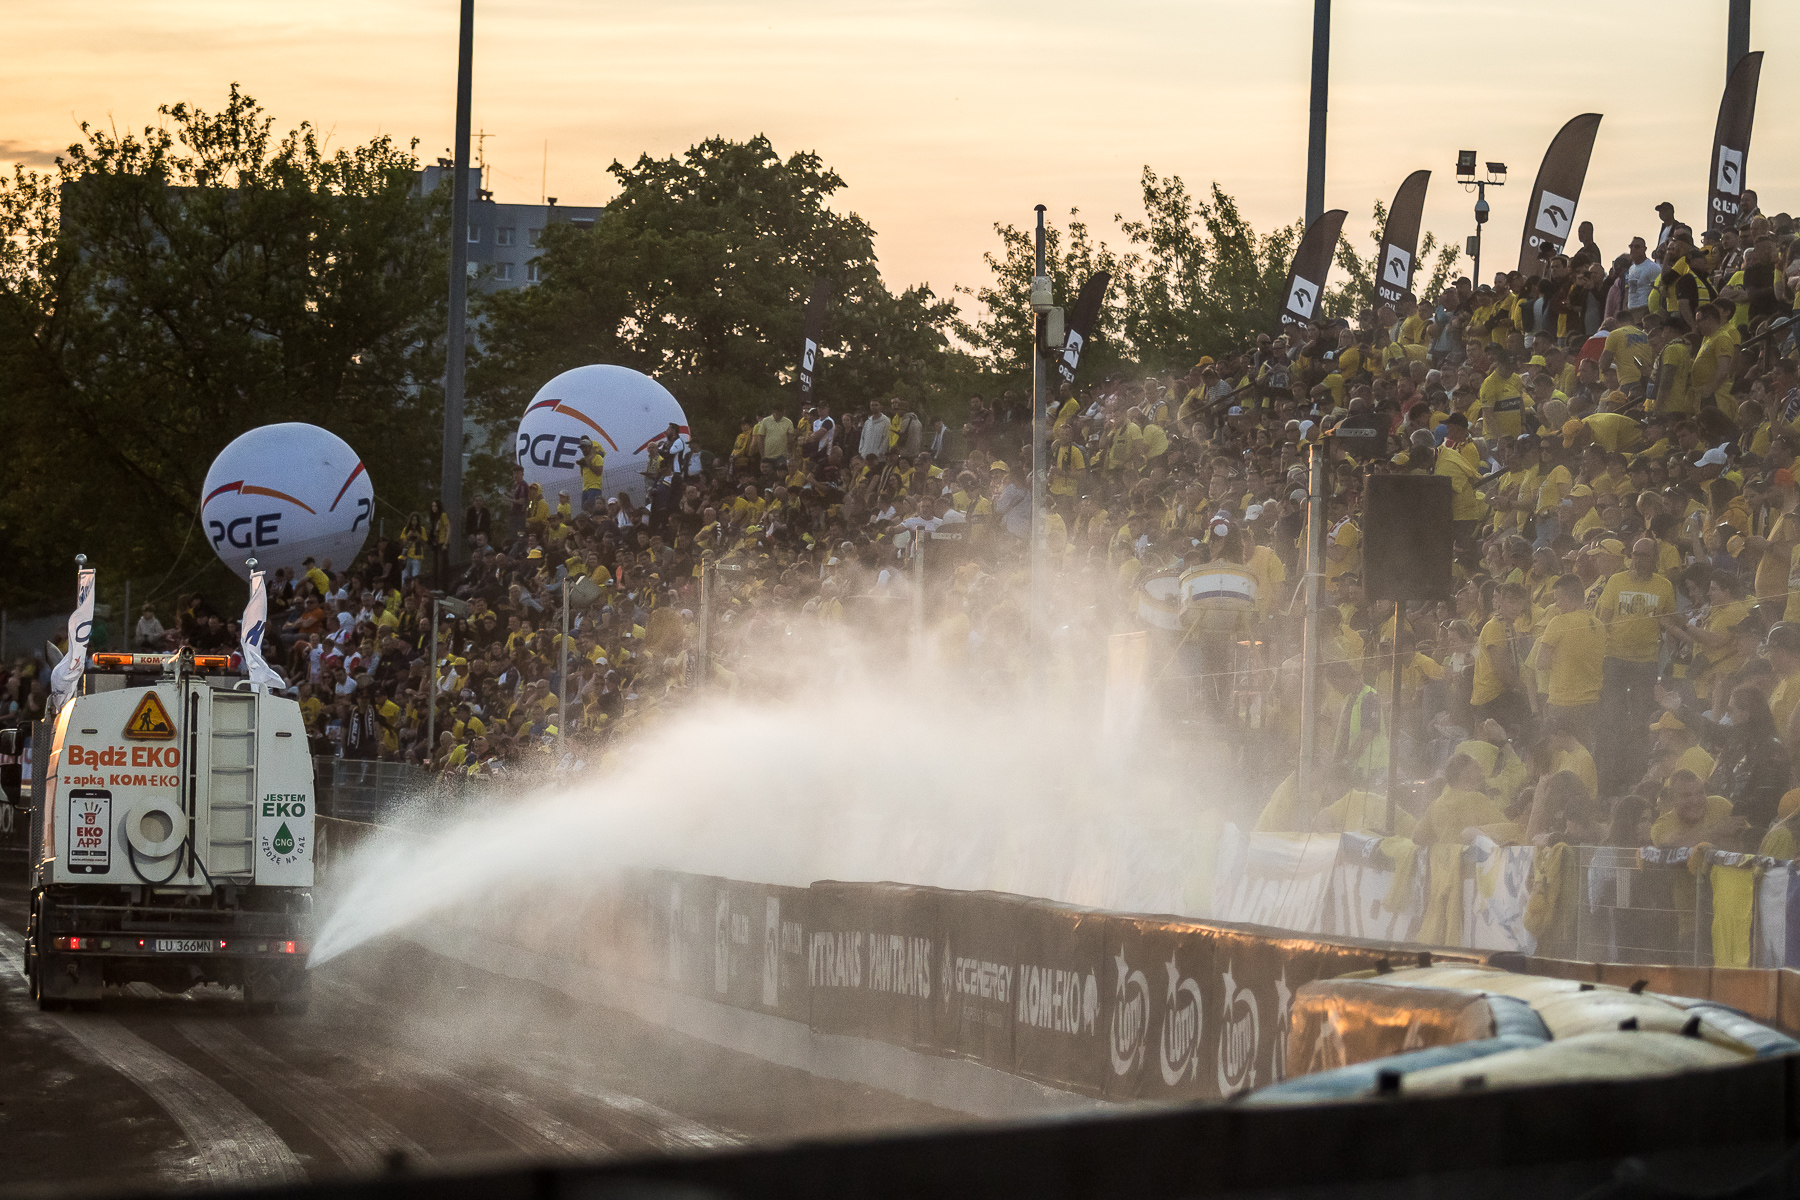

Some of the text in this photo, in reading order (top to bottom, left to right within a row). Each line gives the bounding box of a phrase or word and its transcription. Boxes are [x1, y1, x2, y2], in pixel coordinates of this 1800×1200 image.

[518, 433, 581, 470] PGE
[209, 513, 282, 550] PGE
[68, 745, 180, 771] Bądź EKO
[64, 774, 180, 788] z apką KOM-EKO
[263, 794, 306, 802] JESTEM
[262, 803, 306, 817] EKO
[77, 826, 103, 837] EKO
[77, 837, 102, 848] APP
[274, 838, 293, 847] CNG
[286, 855, 297, 864] NA
[297, 836, 306, 854] GAZ
[158, 940, 211, 952] LU 366MN
[1169, 999, 1195, 1063] LOTTO
